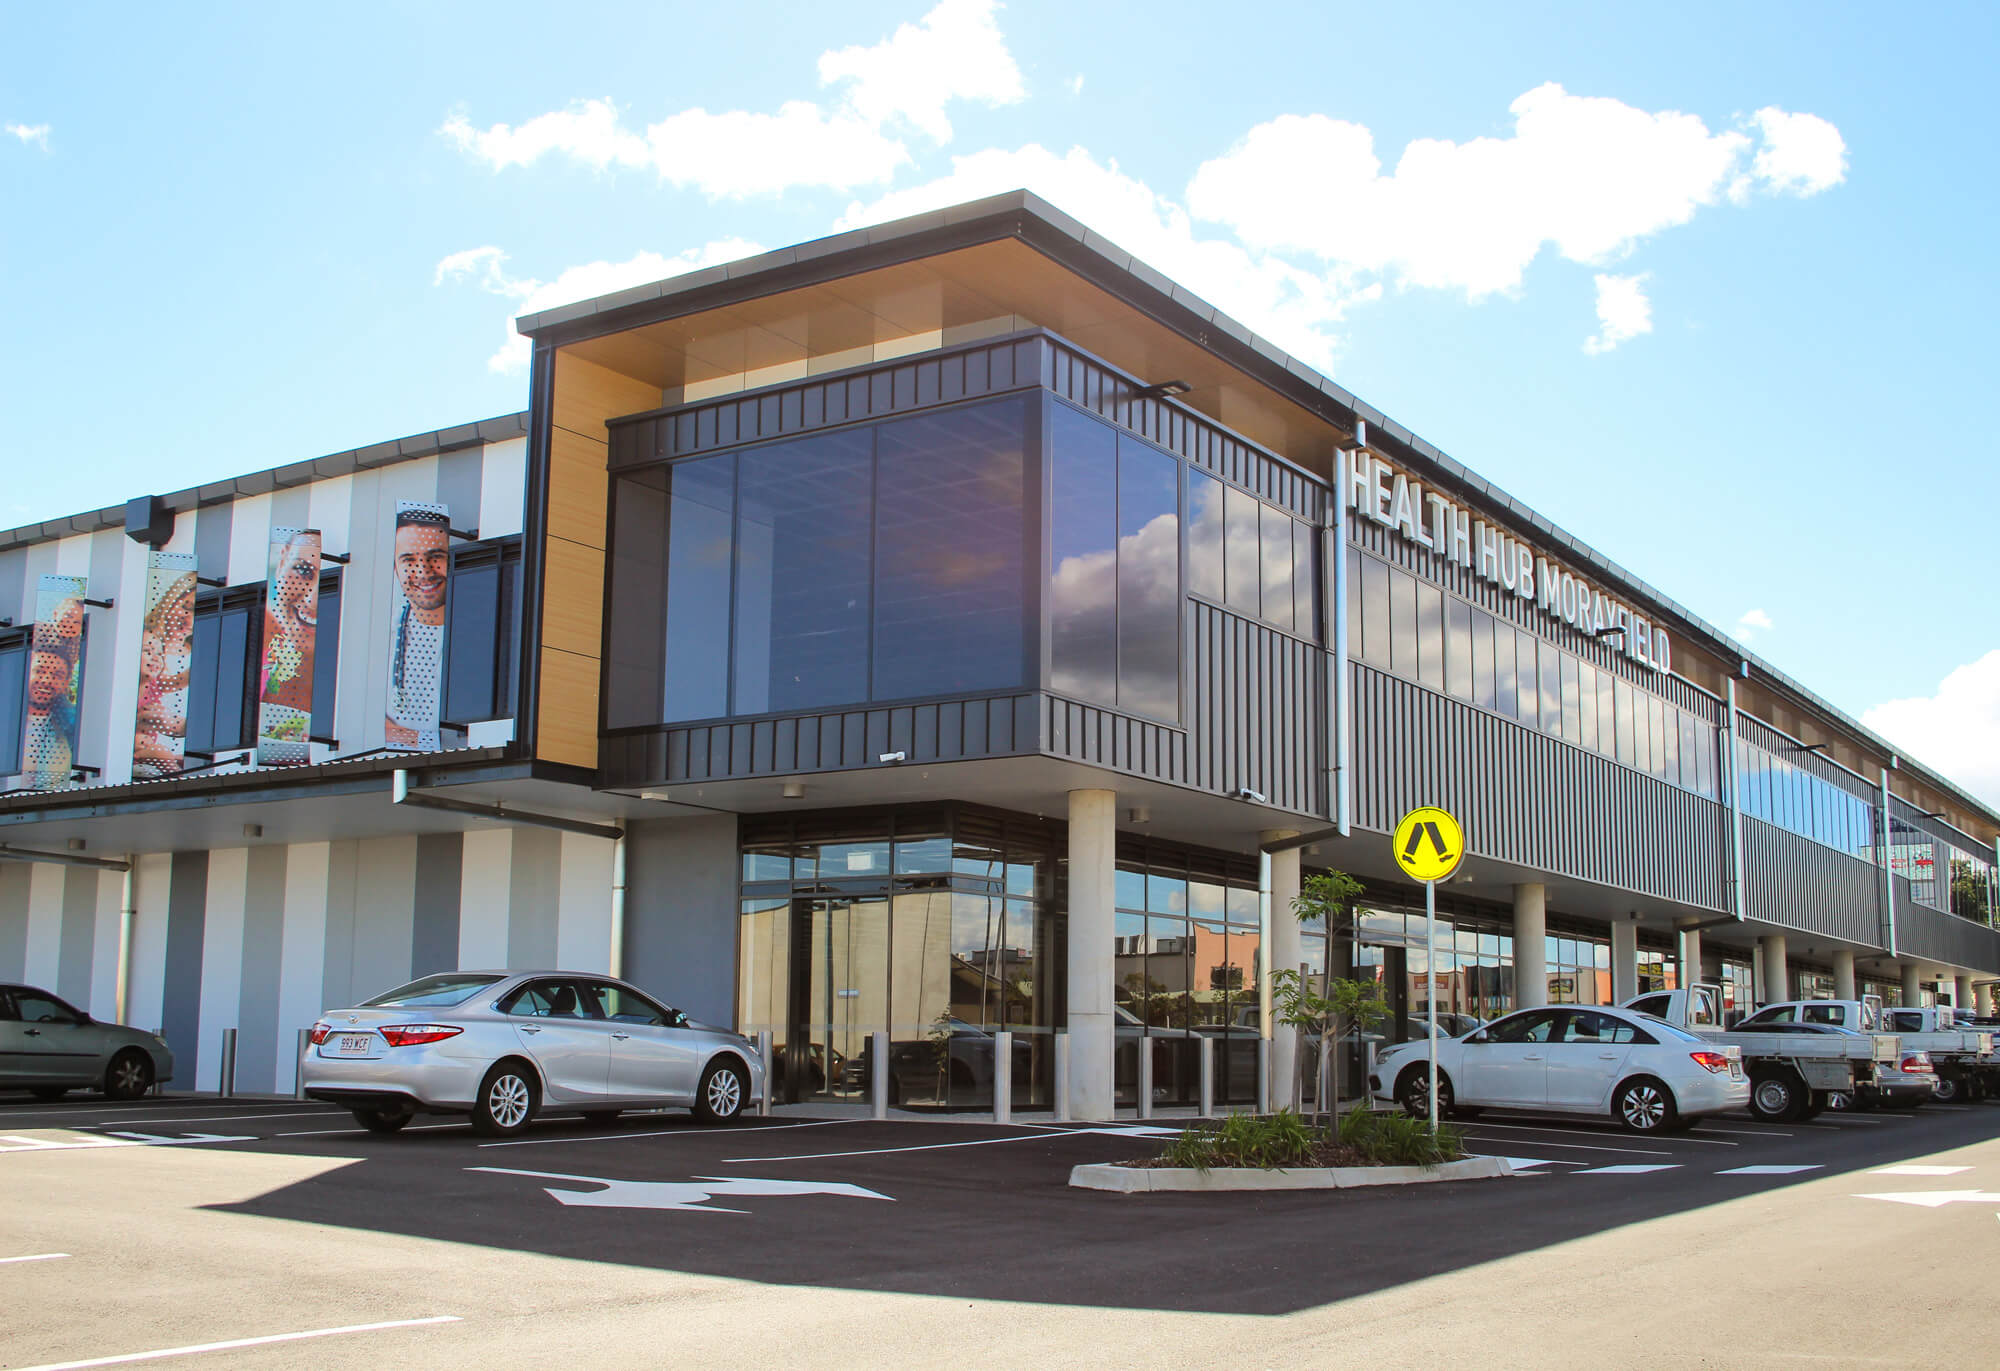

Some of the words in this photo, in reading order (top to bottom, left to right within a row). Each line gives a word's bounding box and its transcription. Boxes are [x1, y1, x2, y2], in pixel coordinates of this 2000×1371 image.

[1347, 450, 1471, 568] HEALTH
[1475, 520, 1535, 601] HUB
[1537, 556, 1672, 676] MORAYFIELD
